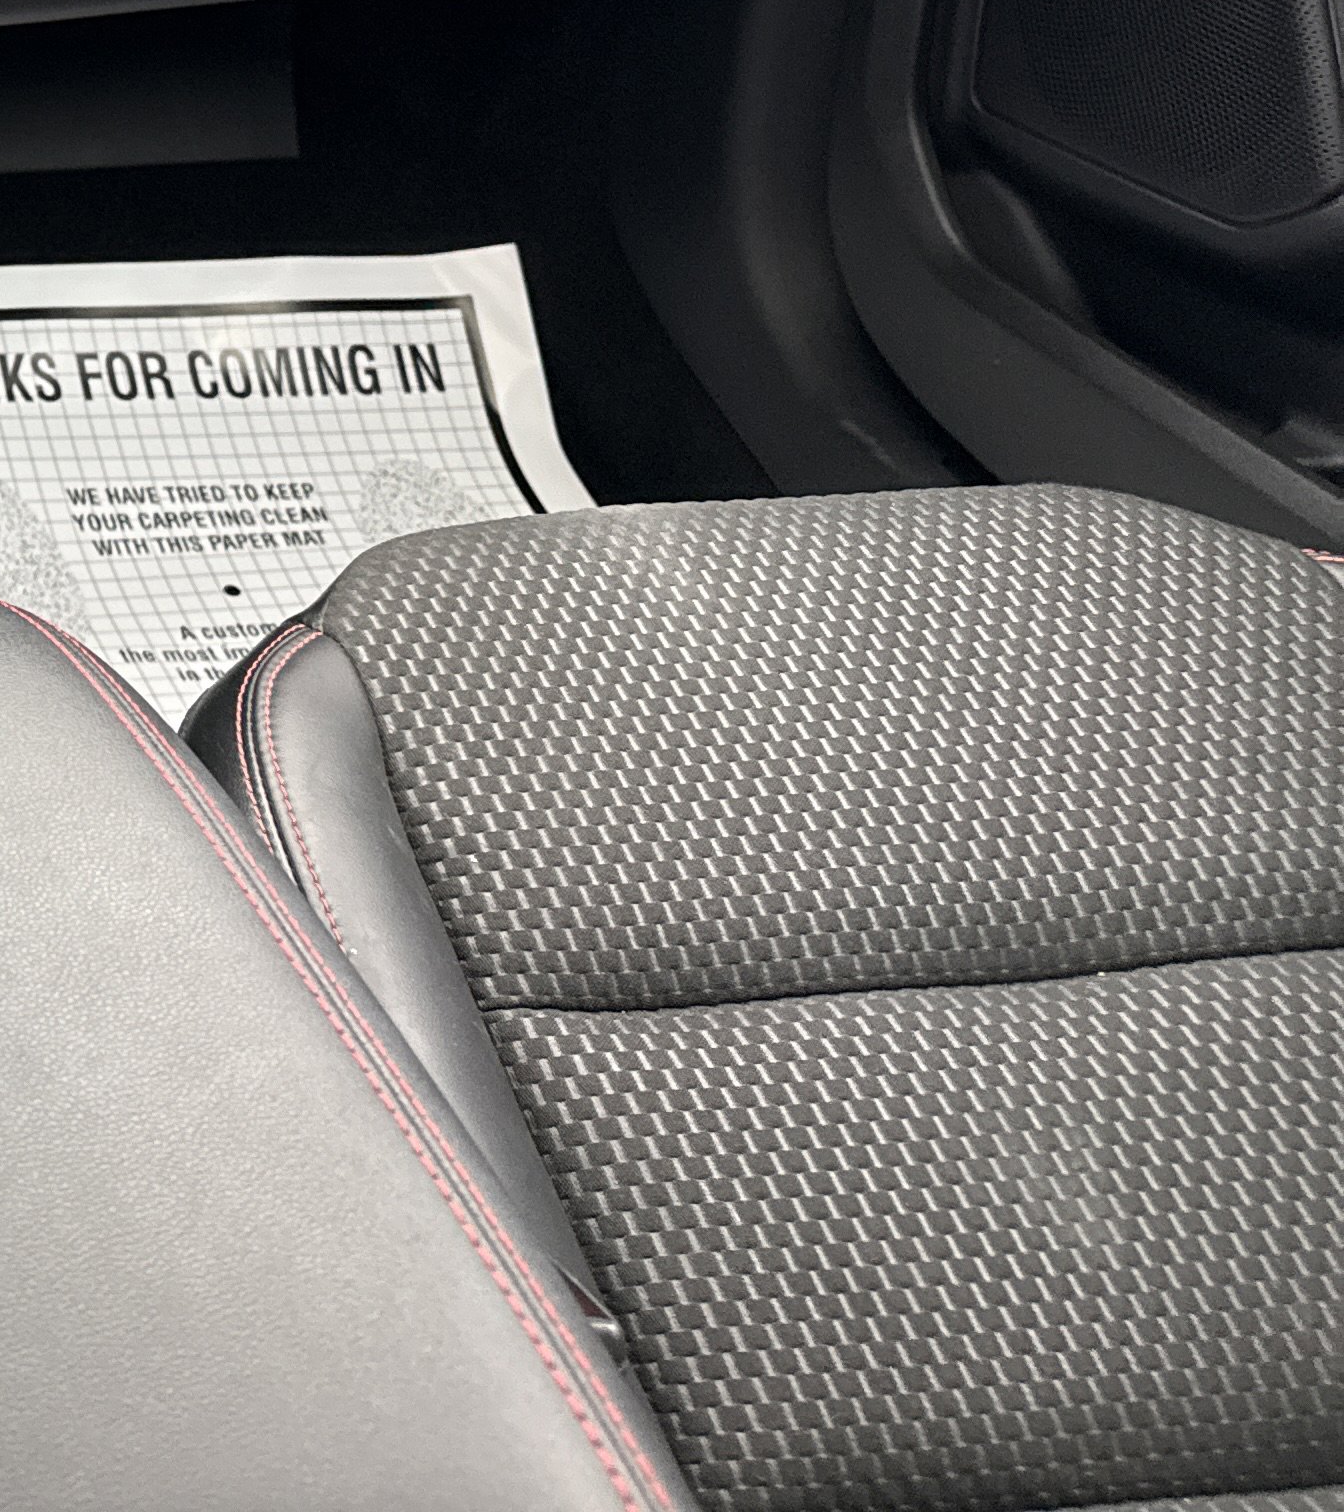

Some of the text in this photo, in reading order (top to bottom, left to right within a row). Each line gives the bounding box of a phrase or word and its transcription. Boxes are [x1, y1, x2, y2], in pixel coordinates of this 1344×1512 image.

[76, 350, 175, 401] FOR
[187, 344, 381, 399] COMING
[394, 342, 445, 393] IN
[66, 482, 315, 506] WE HAVE TRIED TO KEEP
[71, 506, 329, 532] YOUR CARPETING CLEAN
[92, 529, 328, 556] WITH THIS PAPER MAT
[179, 625, 196, 641] A
[119, 647, 155, 664] the
[162, 646, 220, 663] most
[175, 666, 201, 682] in
